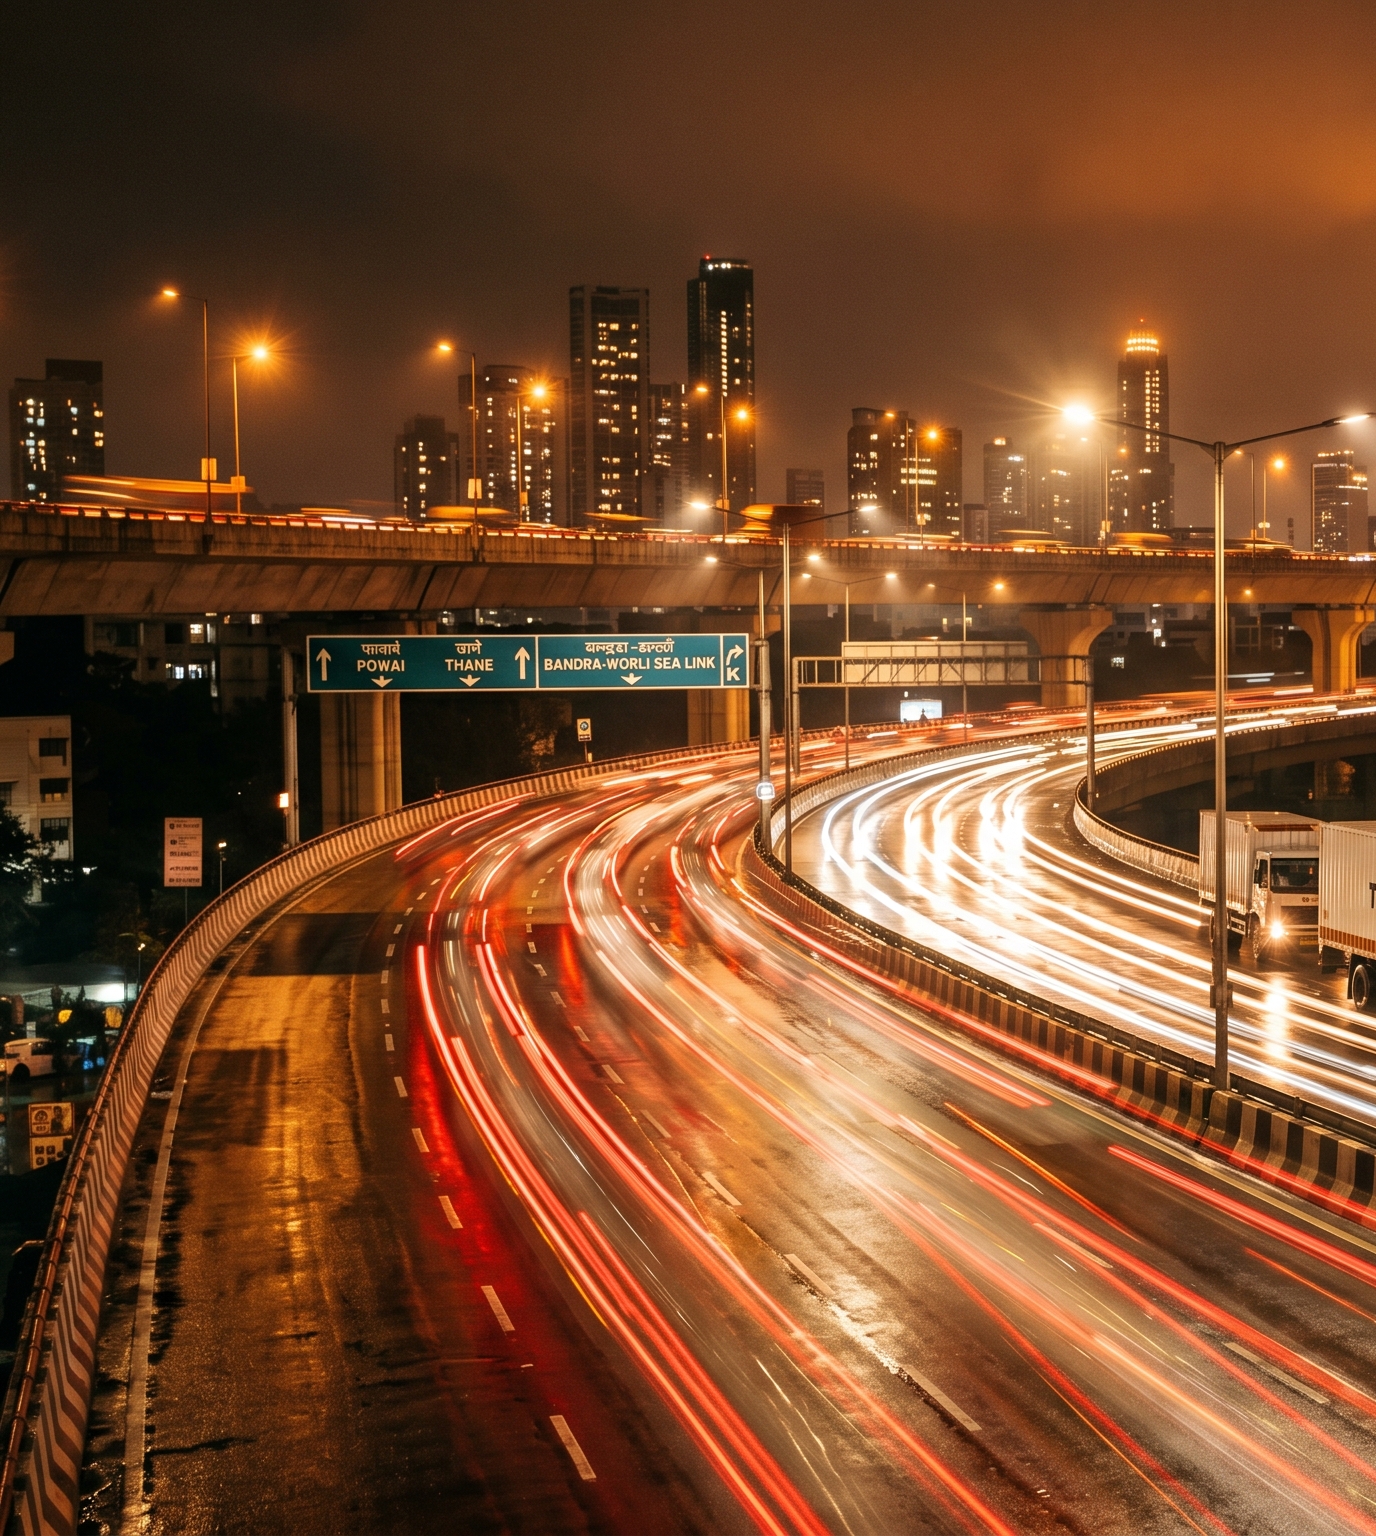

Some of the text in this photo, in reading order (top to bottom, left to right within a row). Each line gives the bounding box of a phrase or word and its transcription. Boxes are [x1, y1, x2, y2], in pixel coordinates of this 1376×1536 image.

[357, 660, 405, 672] POWAI
[445, 659, 494, 671] THANE
[544, 656, 716, 671] BANDRA-WORLI SEA LINK
[726, 667, 741, 682] K
